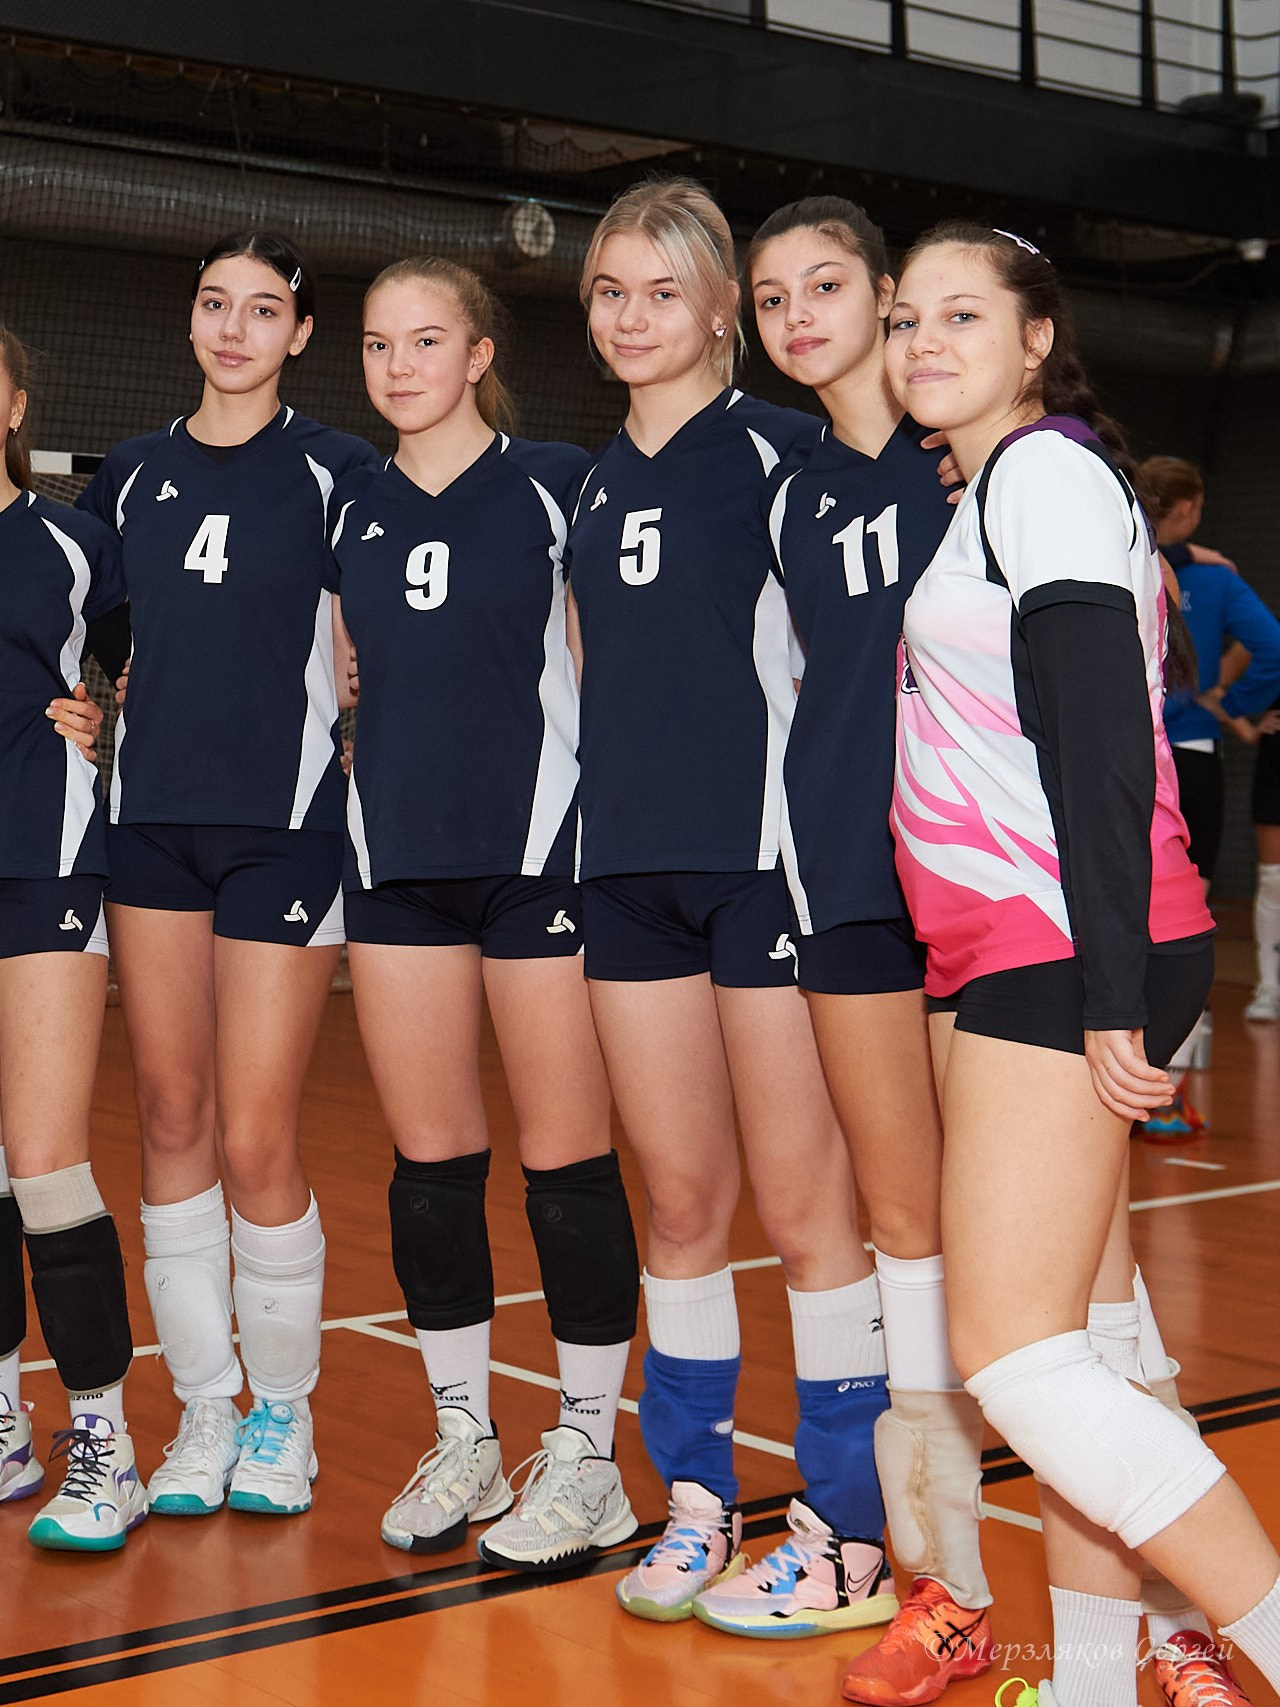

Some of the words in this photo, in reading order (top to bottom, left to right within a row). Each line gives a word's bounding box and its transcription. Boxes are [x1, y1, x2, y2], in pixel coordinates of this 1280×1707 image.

[184, 515, 230, 583] 4
[405, 542, 449, 610] 9
[620, 508, 662, 585] 5
[832, 504, 898, 596] 11
